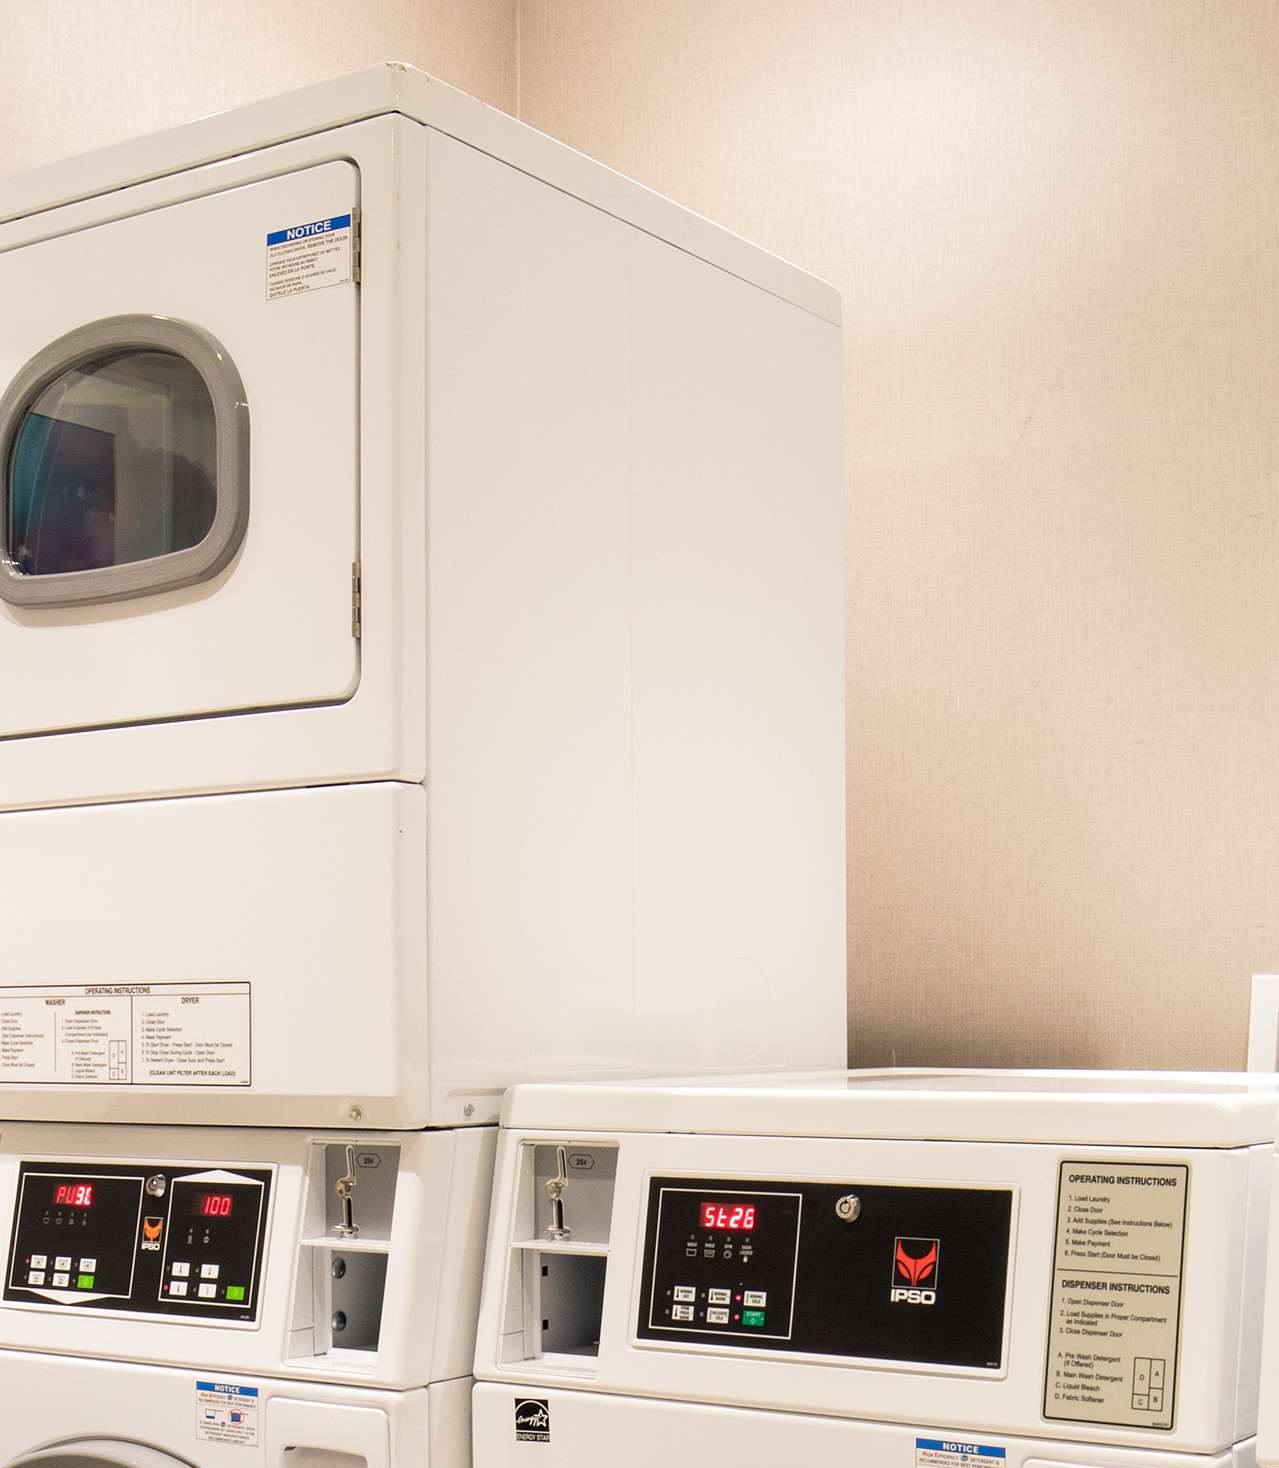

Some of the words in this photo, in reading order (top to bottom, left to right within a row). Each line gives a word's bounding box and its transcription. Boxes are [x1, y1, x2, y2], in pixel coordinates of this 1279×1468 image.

[287, 220, 331, 240] NOTICE
[1069, 1175, 1114, 1184] OPERATING
[1116, 1176, 1177, 1186] INSTRUCTIONS
[204, 1197, 231, 1215] 100
[1062, 1280, 1107, 1290] DISPENSER
[1109, 1282, 1170, 1294] INSTRUCTIONS
[890, 1289, 936, 1304] IPSO
[214, 1384, 240, 1393] NOTICE
[943, 1443, 979, 1454] NOTICE
